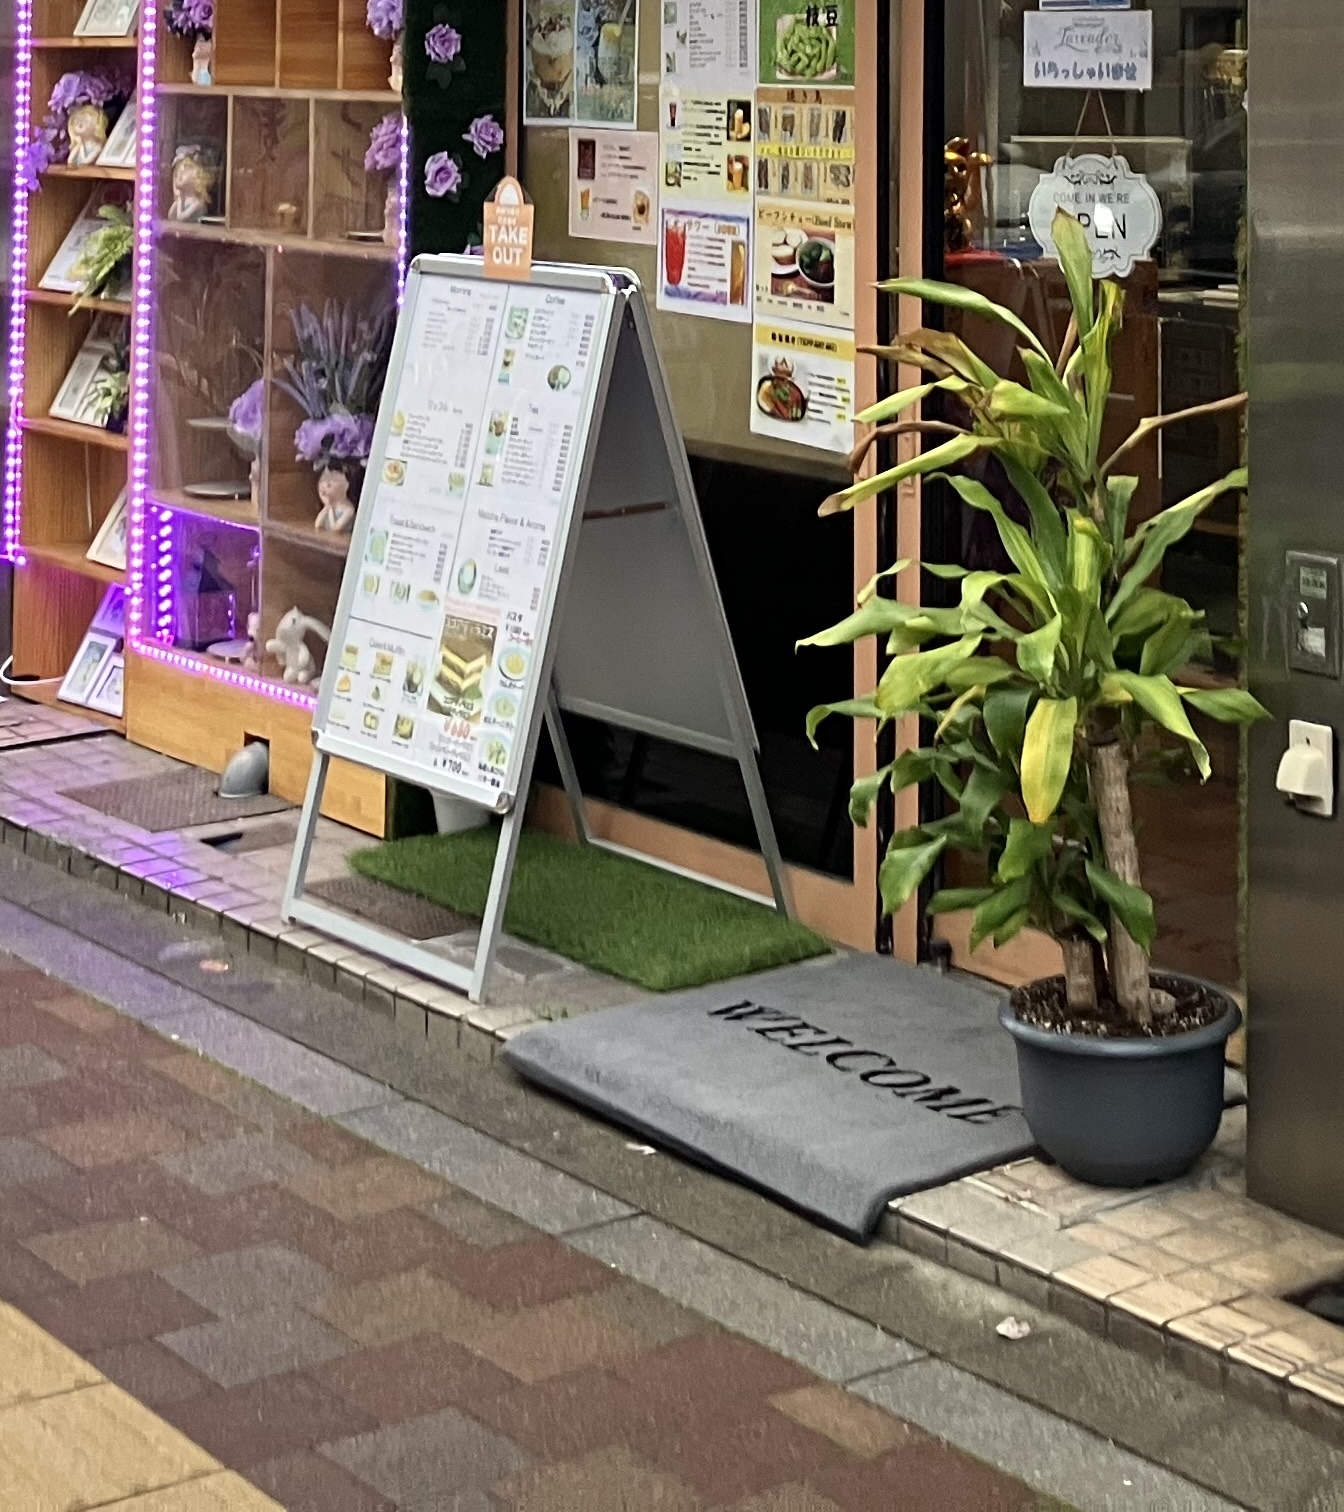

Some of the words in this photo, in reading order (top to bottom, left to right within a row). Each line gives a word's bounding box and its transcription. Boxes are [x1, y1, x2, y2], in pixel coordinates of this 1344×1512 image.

[805, 3, 839, 28] 枝豆
[1085, 192, 1096, 204] IN
[488, 224, 528, 245] TAKE
[492, 245, 523, 266] OUT
[708, 998, 1024, 1125] WELCOME
